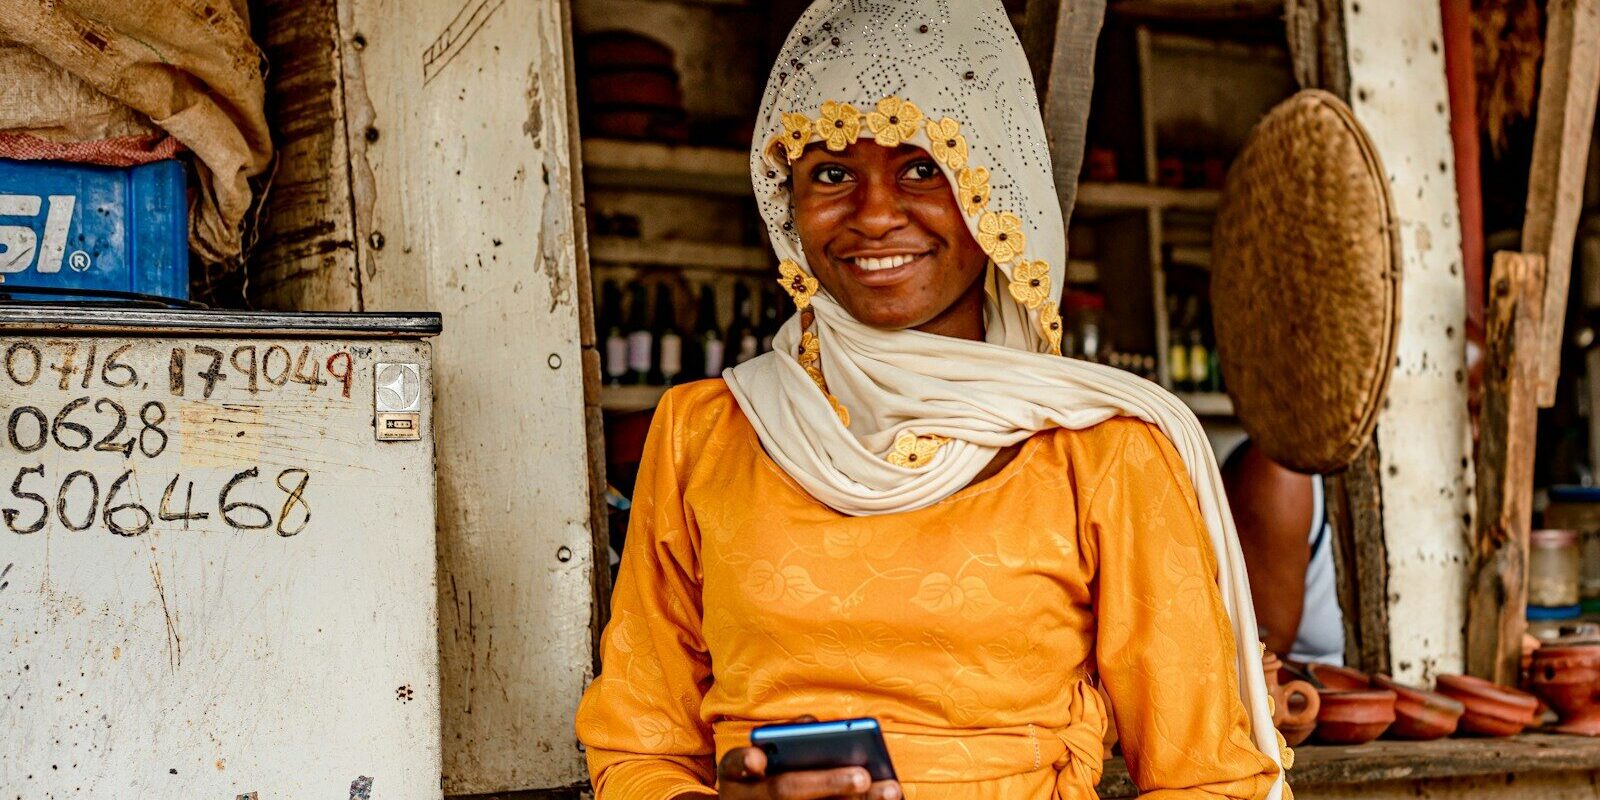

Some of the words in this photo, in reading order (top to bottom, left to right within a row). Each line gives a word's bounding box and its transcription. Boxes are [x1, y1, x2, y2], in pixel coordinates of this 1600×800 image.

[169, 344, 353, 398] 179049
[8, 396, 168, 458] 0628
[2, 464, 311, 537] 506468
